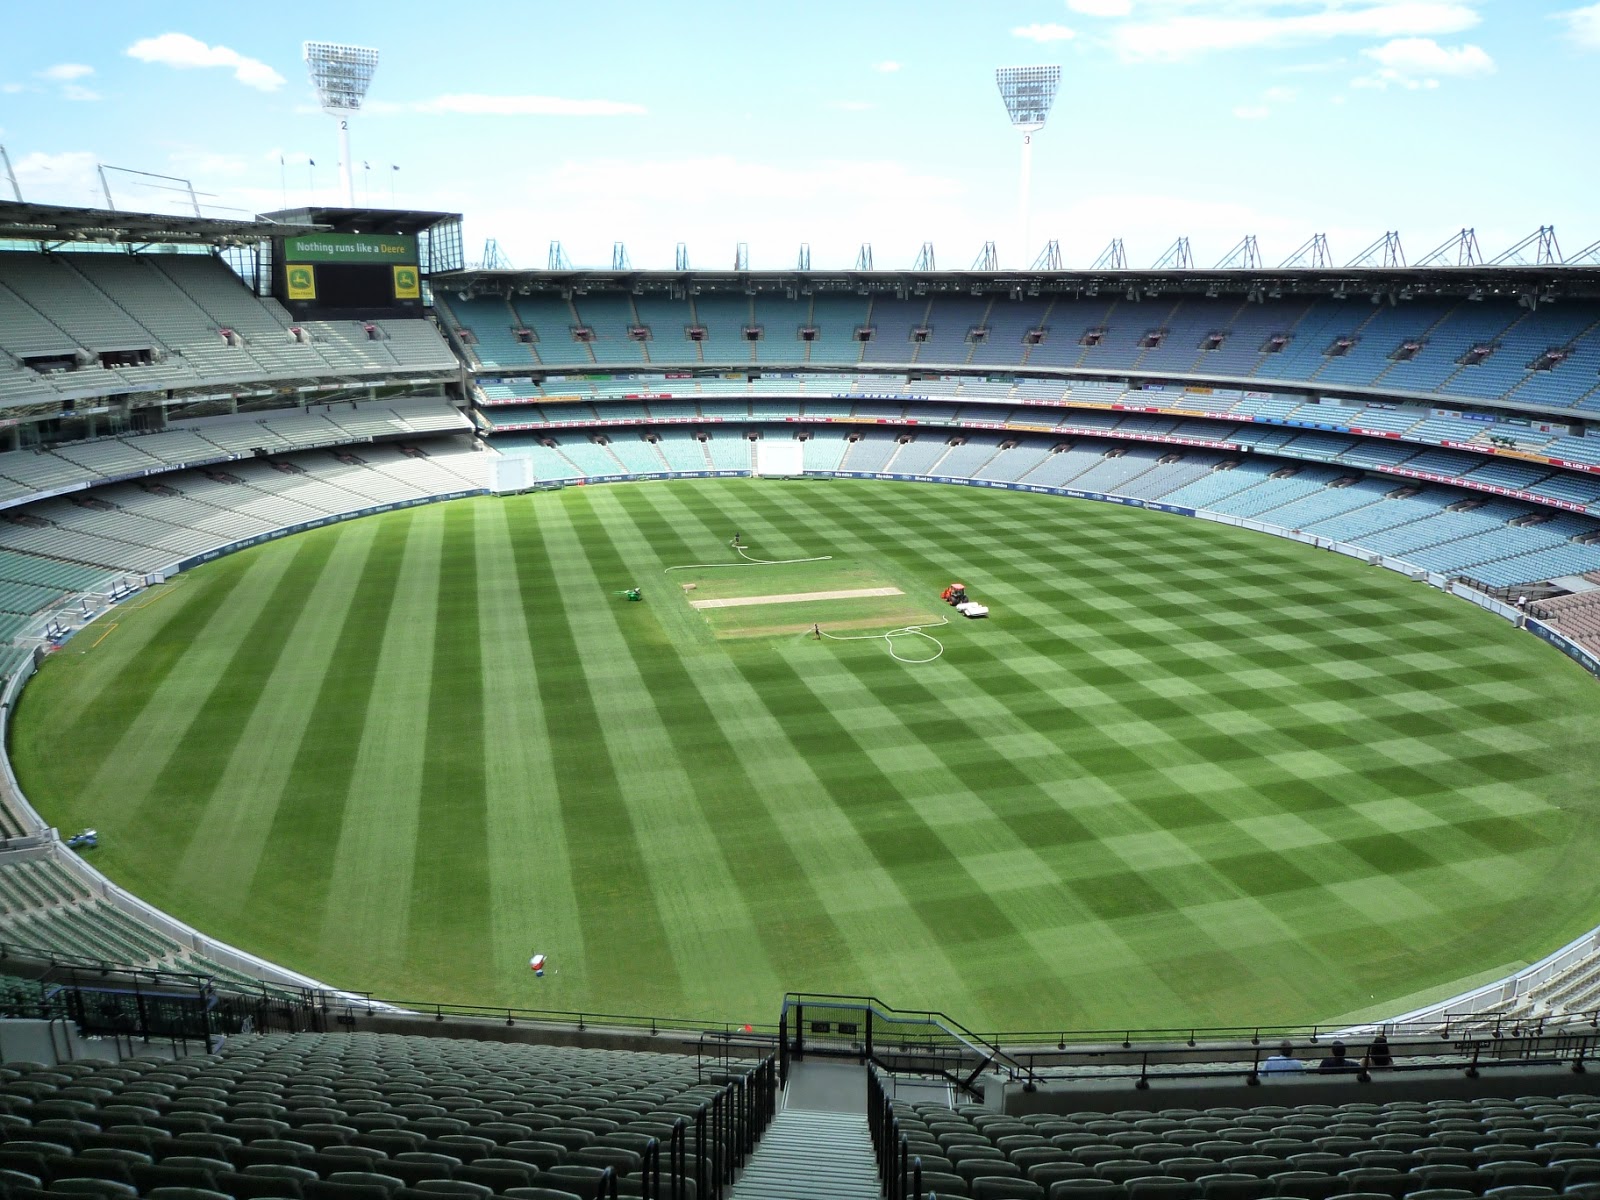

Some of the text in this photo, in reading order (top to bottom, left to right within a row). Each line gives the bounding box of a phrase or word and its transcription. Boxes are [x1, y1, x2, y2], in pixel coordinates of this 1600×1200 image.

[341, 120, 348, 130] 2
[1024, 136, 1030, 144] 3
[296, 241, 334, 254] Nothing
[335, 244, 355, 253] runs
[356, 243, 372, 253] like
[380, 244, 405, 254] Deere
[150, 464, 180, 475] OPEN DAILY
